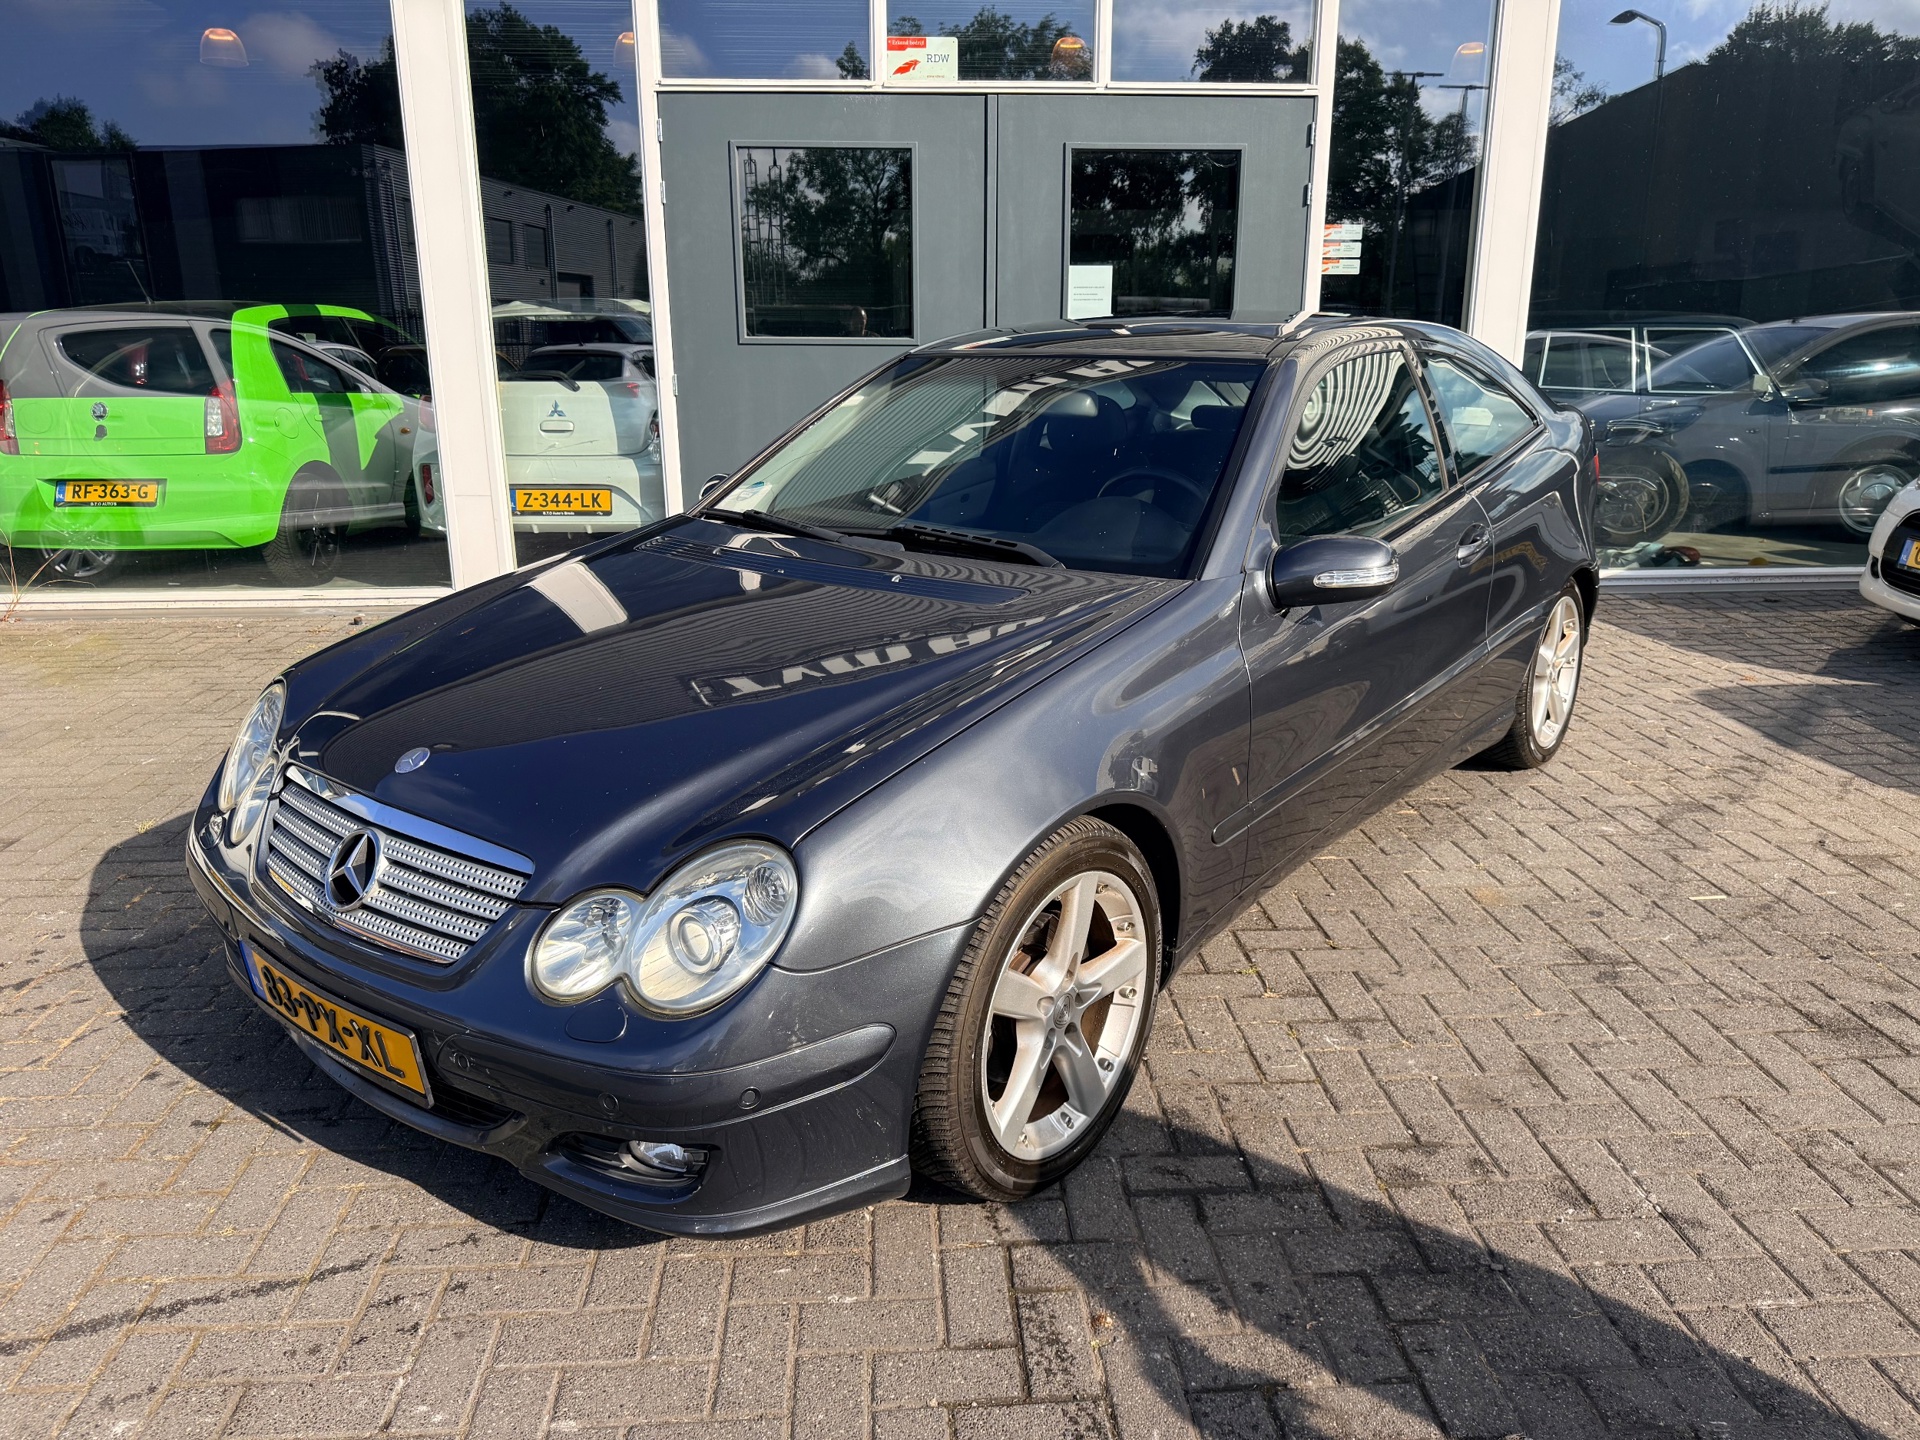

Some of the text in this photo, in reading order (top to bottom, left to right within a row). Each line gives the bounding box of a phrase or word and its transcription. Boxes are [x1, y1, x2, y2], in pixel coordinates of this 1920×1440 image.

[926, 53, 950, 63] RDW
[72, 484, 148, 498] RF-363-G
[523, 493, 602, 507] Z-344-LK
[260, 964, 406, 1079] 83-PX-XL
